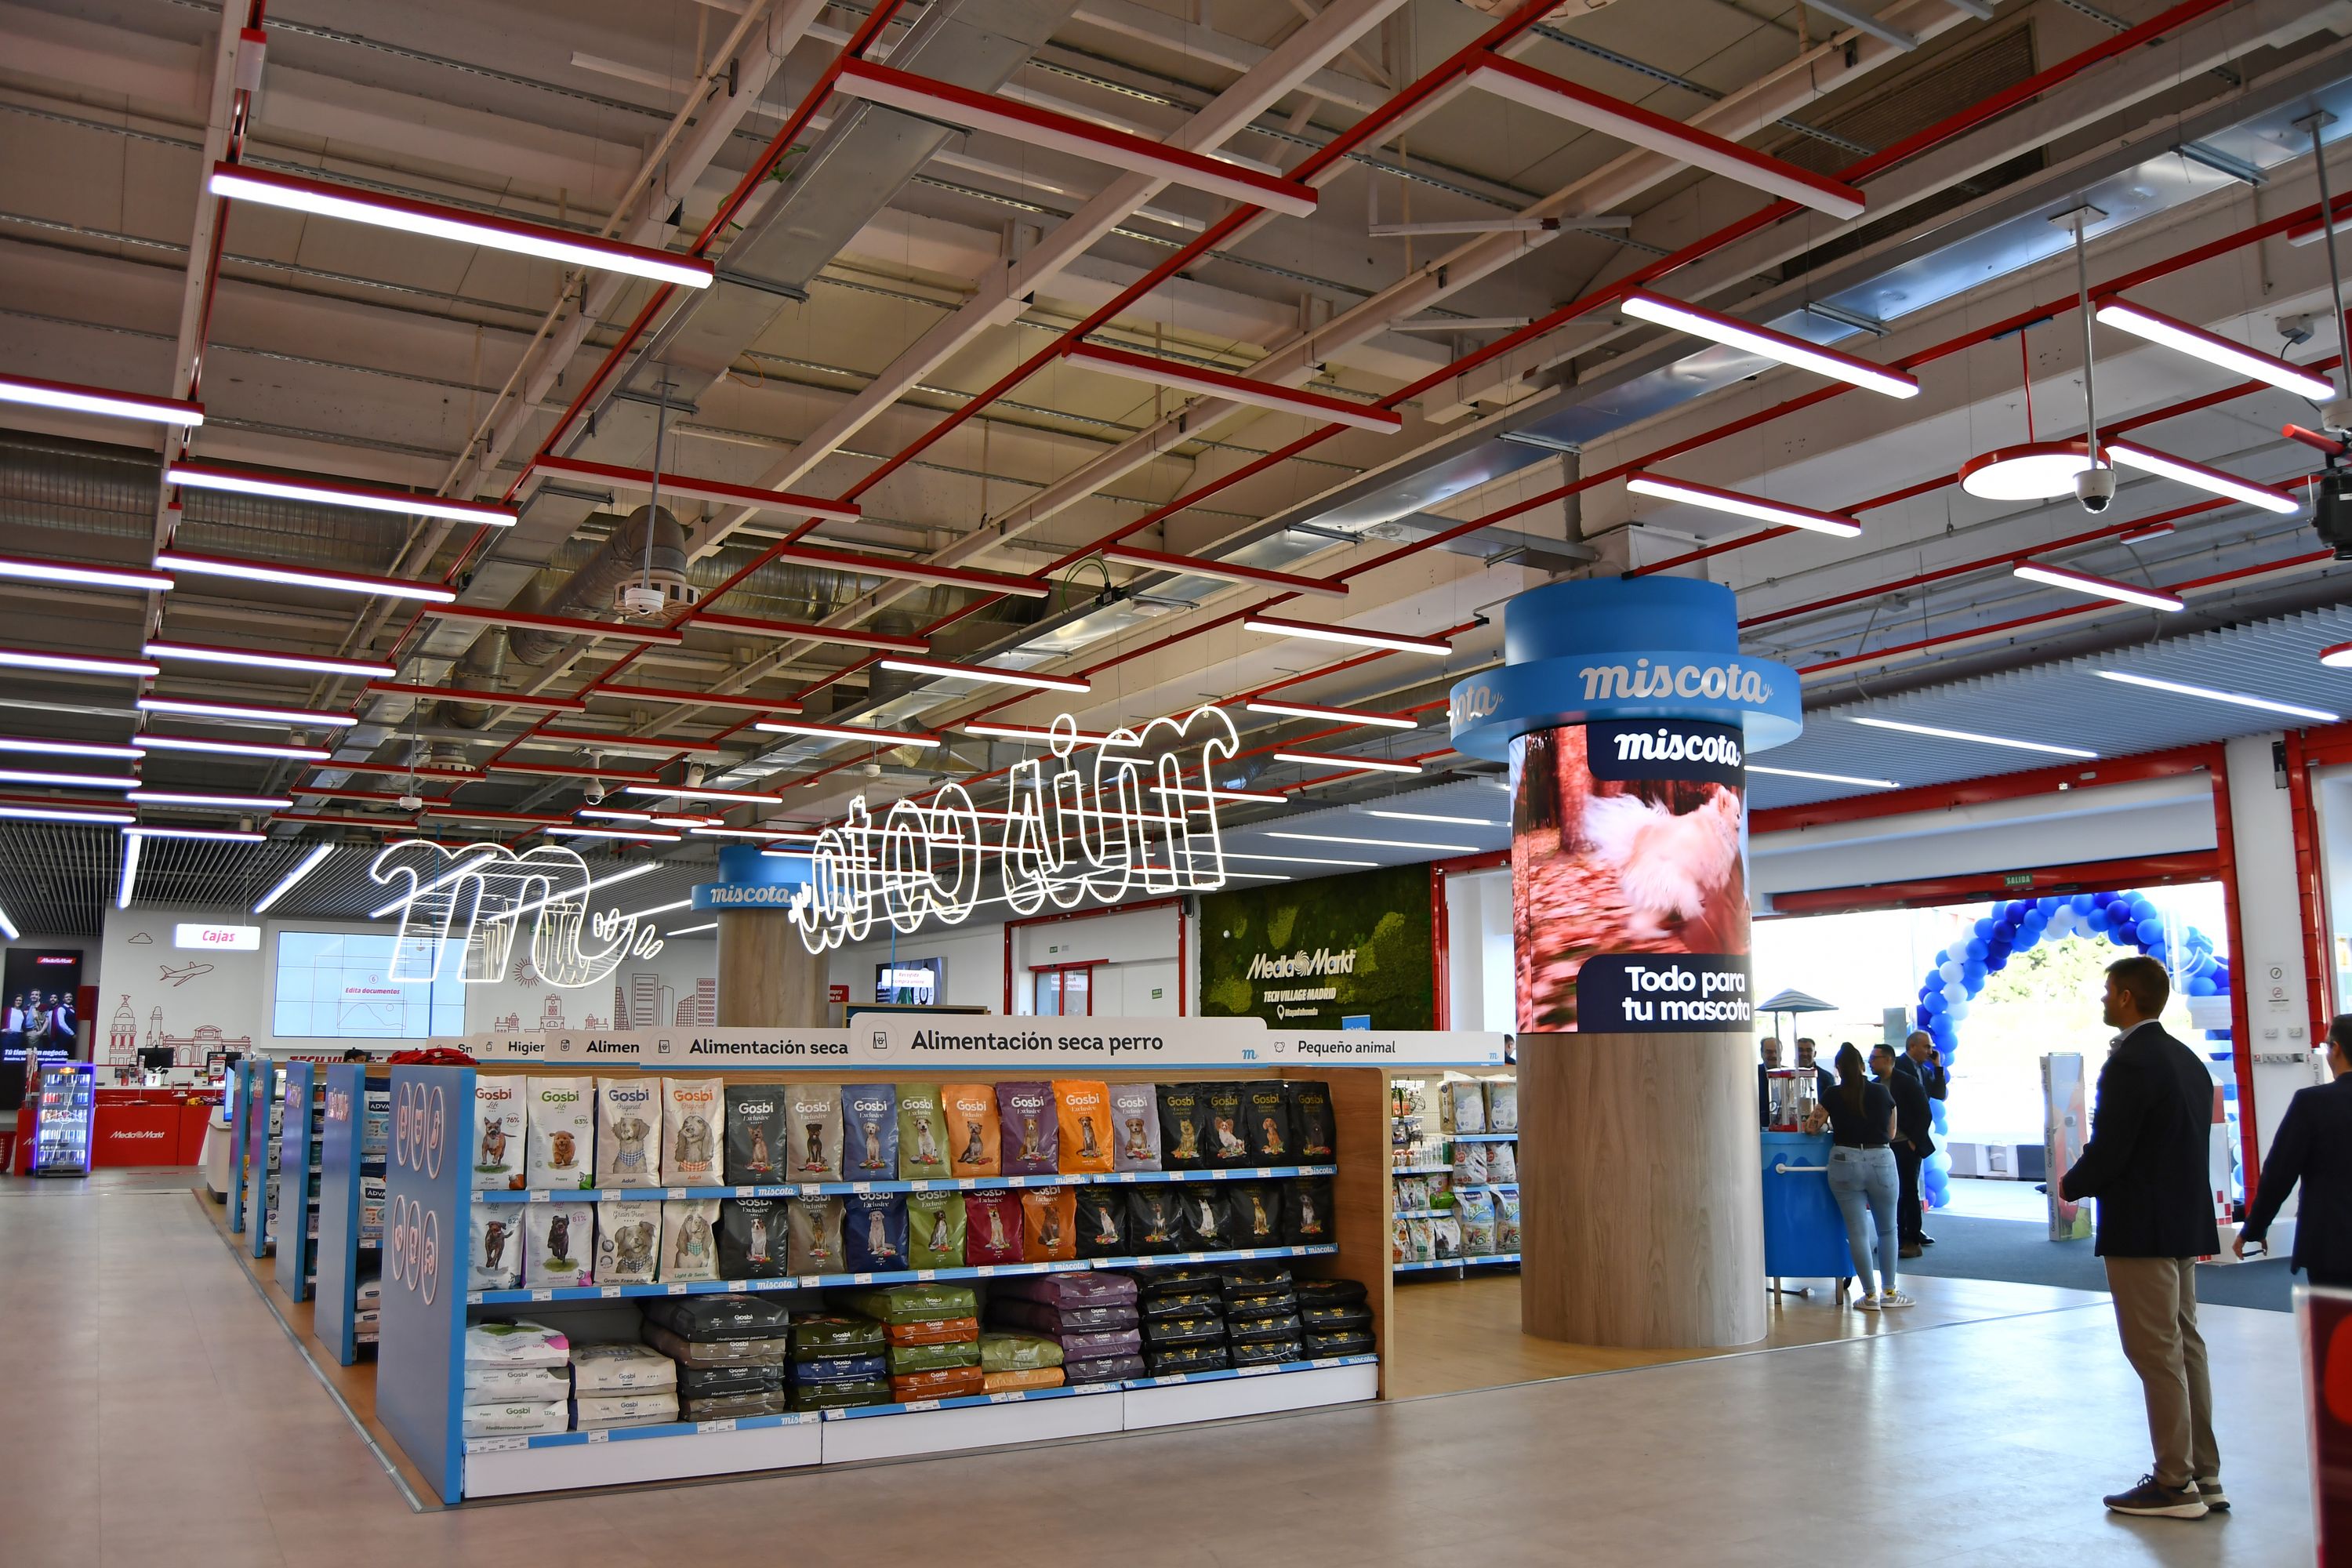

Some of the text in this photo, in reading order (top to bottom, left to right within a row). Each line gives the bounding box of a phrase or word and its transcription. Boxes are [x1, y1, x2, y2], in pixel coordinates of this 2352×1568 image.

[1579, 659, 1772, 704] miscota
[1613, 728, 1742, 768] miscota
[2007, 875, 2031, 884] SALIDA
[710, 884, 792, 903] miscota
[202, 930, 235, 944] Cajas
[1624, 965, 1745, 1001] Todo para
[1264, 987, 1337, 1003] TECH VILLAGE MADRID
[1622, 996, 1751, 1022] tu mascota
[689, 1038, 848, 1055] Alimentación seca
[911, 1029, 1163, 1058] Alimentación seca perro
[1298, 1040, 1396, 1058] Pequeño animal
[476, 1087, 512, 1101] Gosbi
[541, 1090, 579, 1102] Gosbi
[608, 1089, 649, 1102] Gosbi
[673, 1090, 713, 1102] Gosbi
[1066, 1094, 1100, 1105] Gosbi
[1253, 1094, 1279, 1104] Gosbi
[1298, 1094, 1323, 1104] Gosbi
[615, 1102, 641, 1111] Original
[796, 1101, 831, 1113] Gosbi
[854, 1100, 887, 1112] Gosbi
[902, 1098, 934, 1110] Gosbi
[956, 1100, 987, 1111] Gosbi
[1011, 1096, 1044, 1108] Gosbi
[1117, 1097, 1148, 1108] Gosbi
[1167, 1096, 1195, 1106] Gosbi
[1210, 1096, 1238, 1106] Gosbi
[739, 1102, 774, 1113] Gosbi
[758, 1186, 795, 1196] miscota
[1308, 1246, 1335, 1254] miscota
[1054, 1262, 1086, 1271] miscota
[757, 1279, 793, 1290] miscota
[1348, 1356, 1376, 1364] miscota
